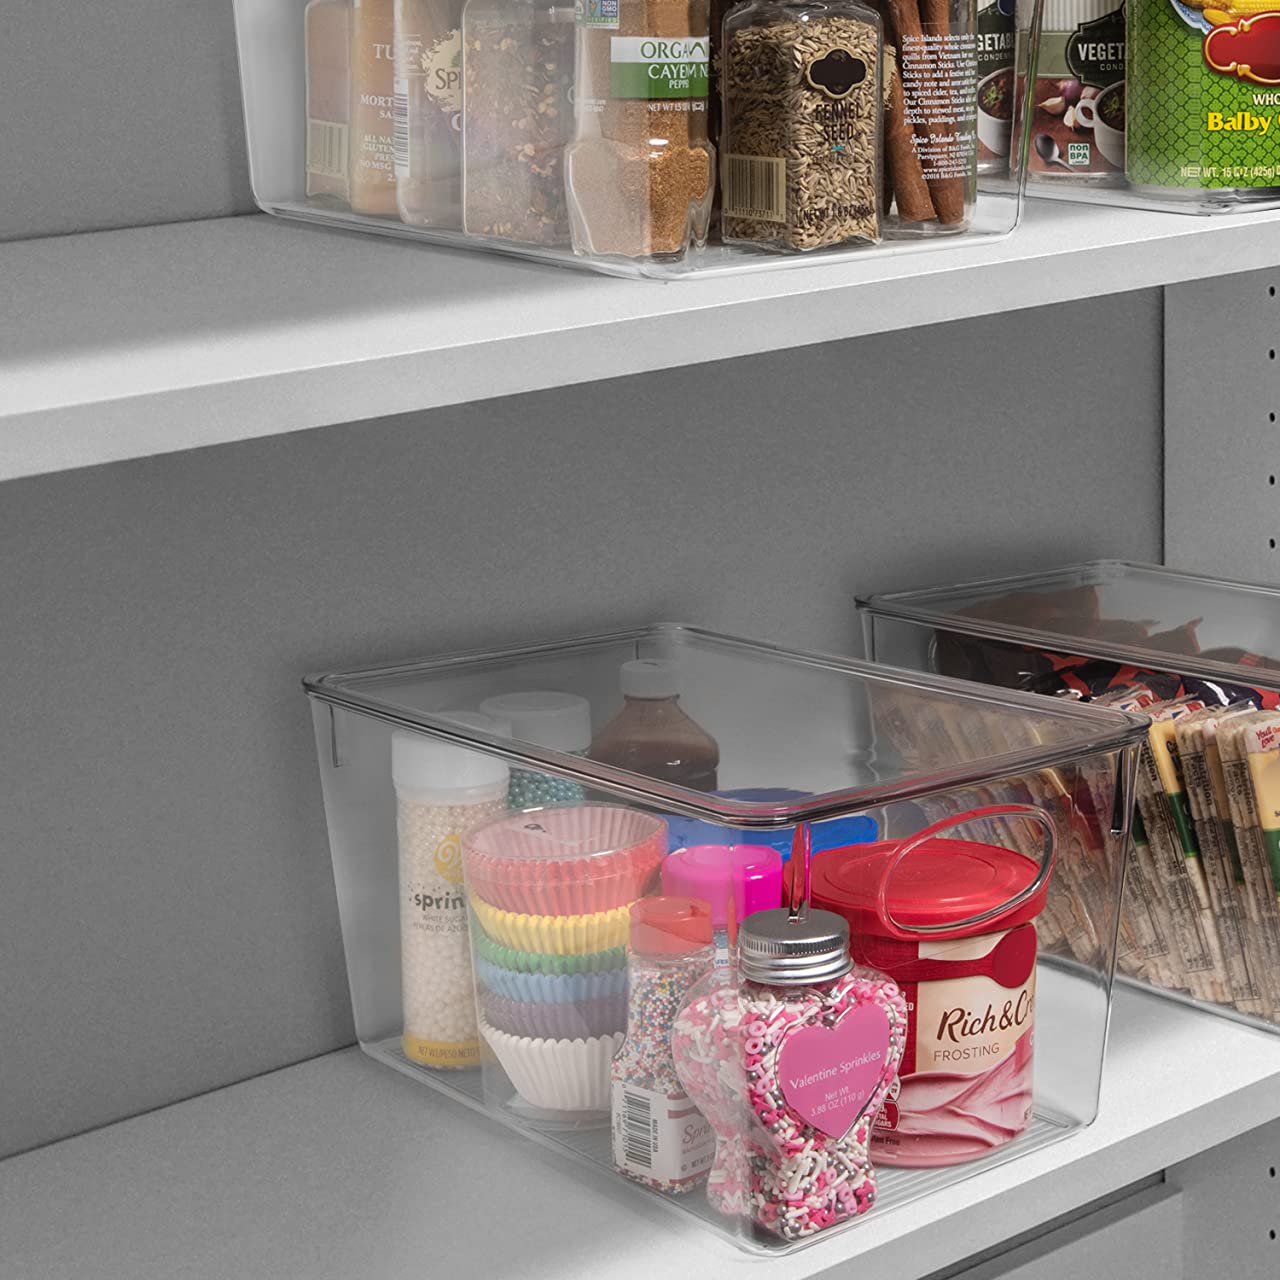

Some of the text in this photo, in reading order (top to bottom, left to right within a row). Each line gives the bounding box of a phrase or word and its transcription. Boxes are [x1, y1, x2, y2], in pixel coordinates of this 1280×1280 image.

[902, 34, 920, 45] Spice
[920, 34, 943, 42] Islands
[921, 53, 938, 61] from
[902, 61, 937, 70] Cinnamon
[903, 98, 917, 106] Our
[918, 97, 950, 106] Cinnamon
[823, 123, 854, 141] SEED
[1069, 152, 1089, 160] BPA
[414, 891, 465, 912] sprin
[933, 1042, 1000, 1062] FROSTING
[789, 1050, 881, 1089] Valentine Sprinkles
[824, 1092, 838, 1101] Net
